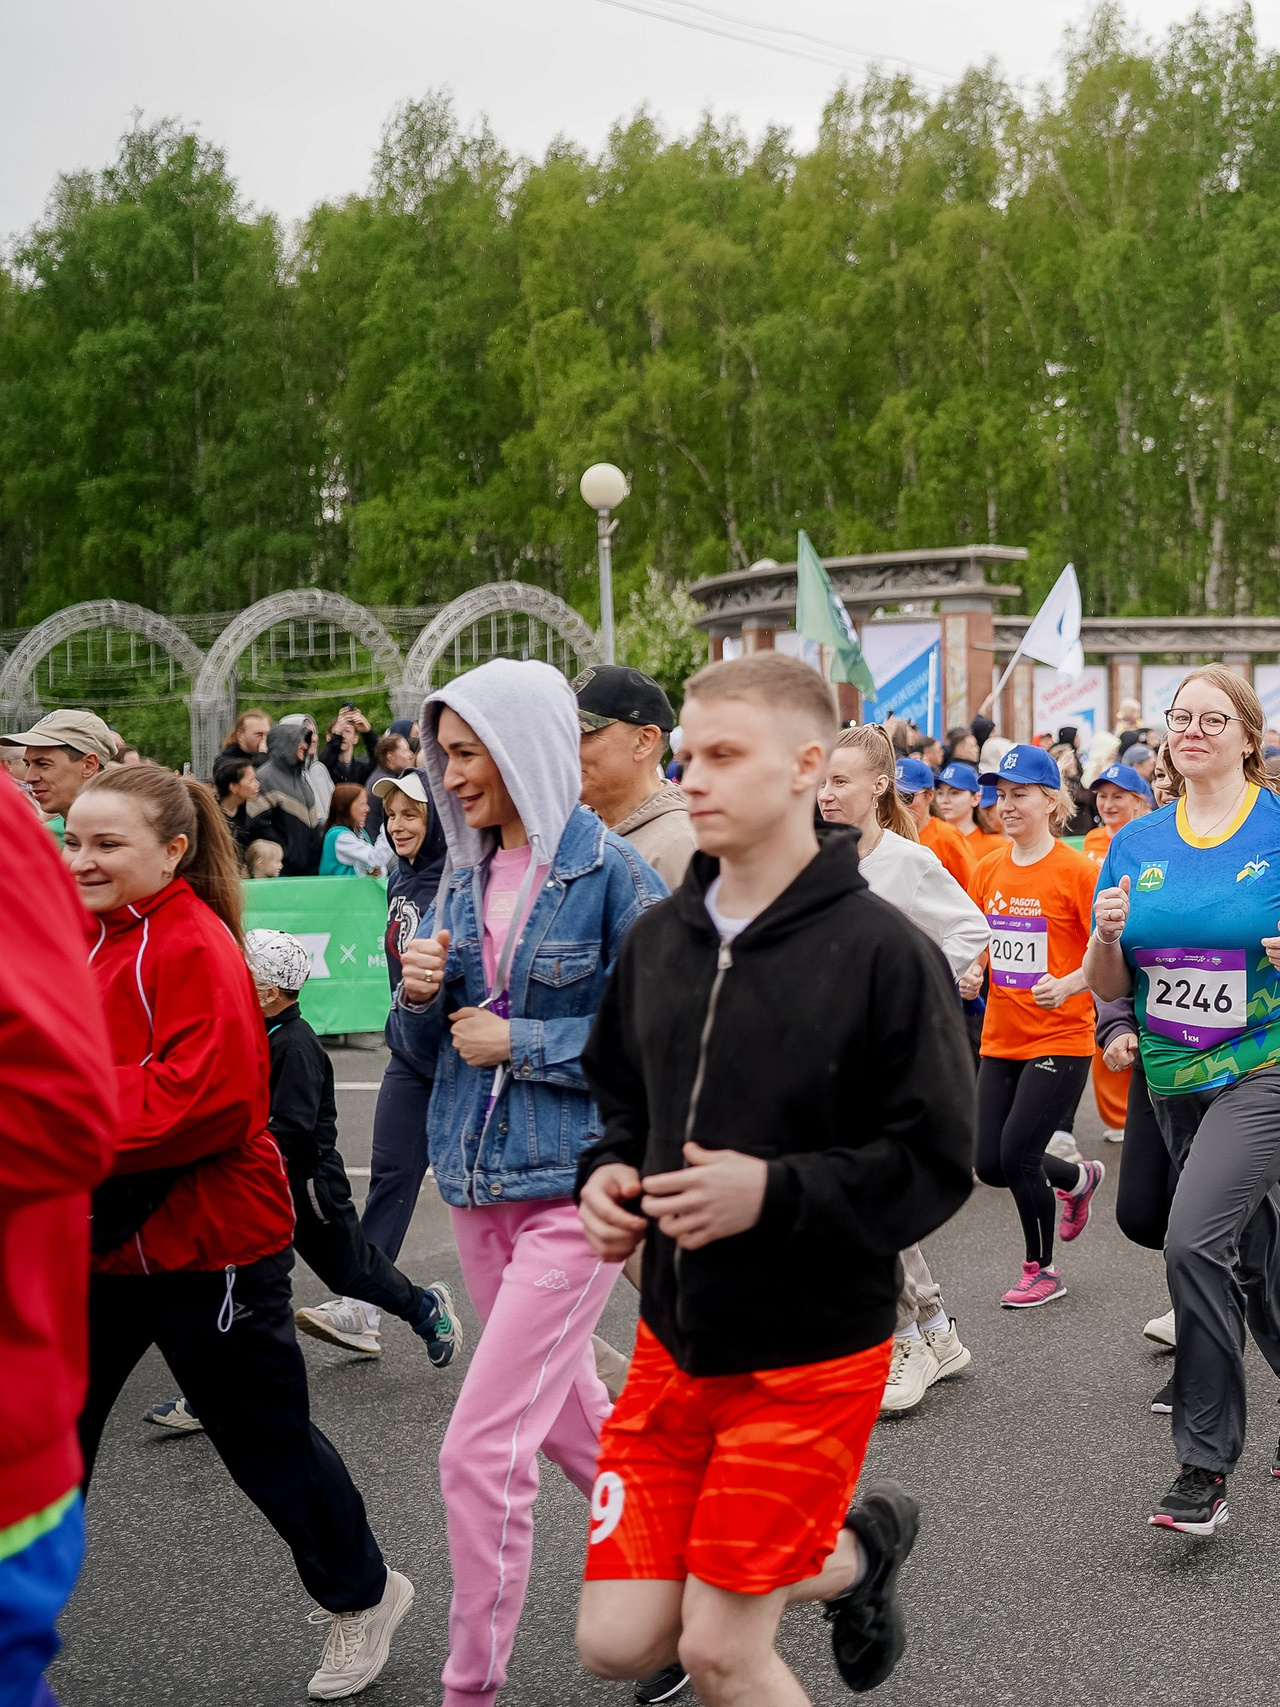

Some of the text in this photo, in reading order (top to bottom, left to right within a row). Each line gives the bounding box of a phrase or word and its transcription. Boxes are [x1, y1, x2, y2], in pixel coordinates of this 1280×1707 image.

[1009, 906, 1042, 916] РОССИИ
[1010, 896, 1040, 907] РАБОТА
[992, 939, 1036, 962] 2021
[1155, 979, 1232, 1013] 2246
[590, 1470, 625, 1545] 9
